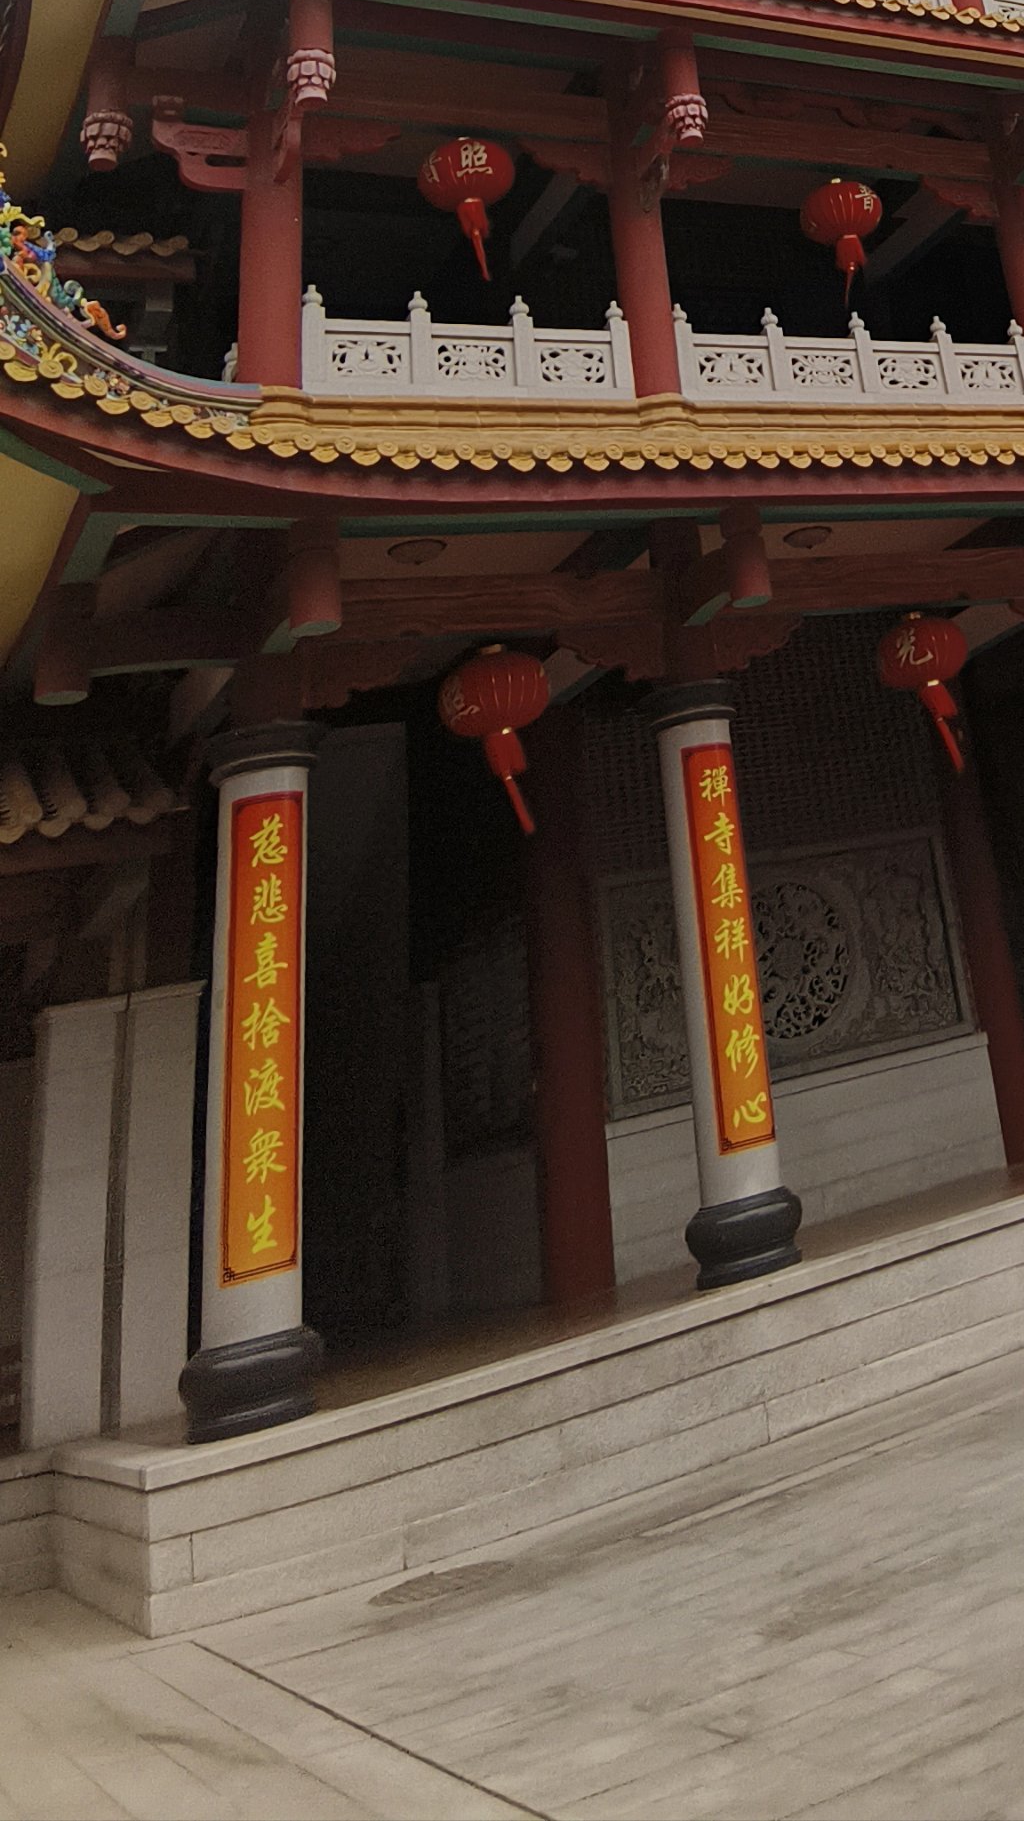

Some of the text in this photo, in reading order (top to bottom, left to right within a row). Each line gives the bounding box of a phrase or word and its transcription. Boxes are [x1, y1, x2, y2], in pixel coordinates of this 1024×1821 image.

[456, 141, 493, 178] 照
[896, 626, 934, 669] 光
[699, 765, 768, 1130] 禪寺集祥好修心
